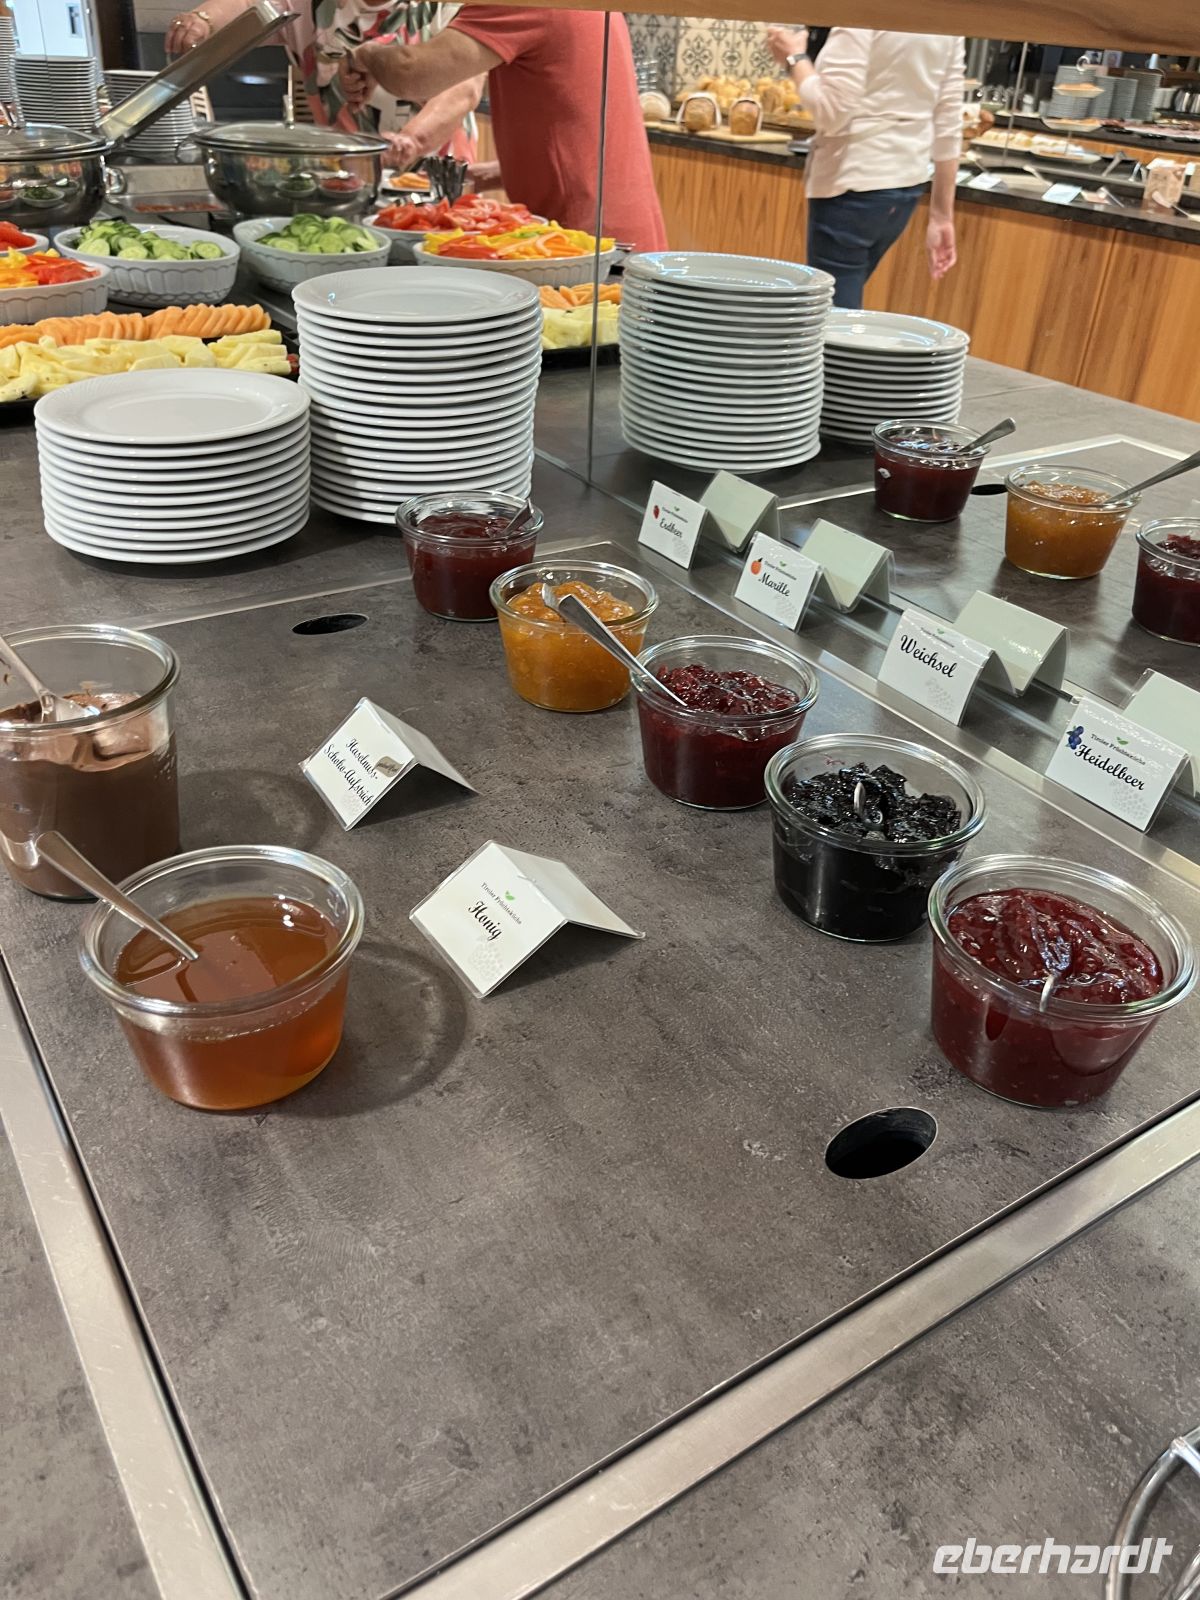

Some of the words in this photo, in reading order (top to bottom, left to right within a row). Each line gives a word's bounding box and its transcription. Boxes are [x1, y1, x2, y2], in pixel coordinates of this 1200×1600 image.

[758, 572, 790, 597] Marille
[900, 634, 958, 678] Weichsel
[324, 743, 375, 806] Schoko-Aufstrich
[1074, 744, 1145, 791] Heidelbeer
[468, 900, 502, 942] Honig
